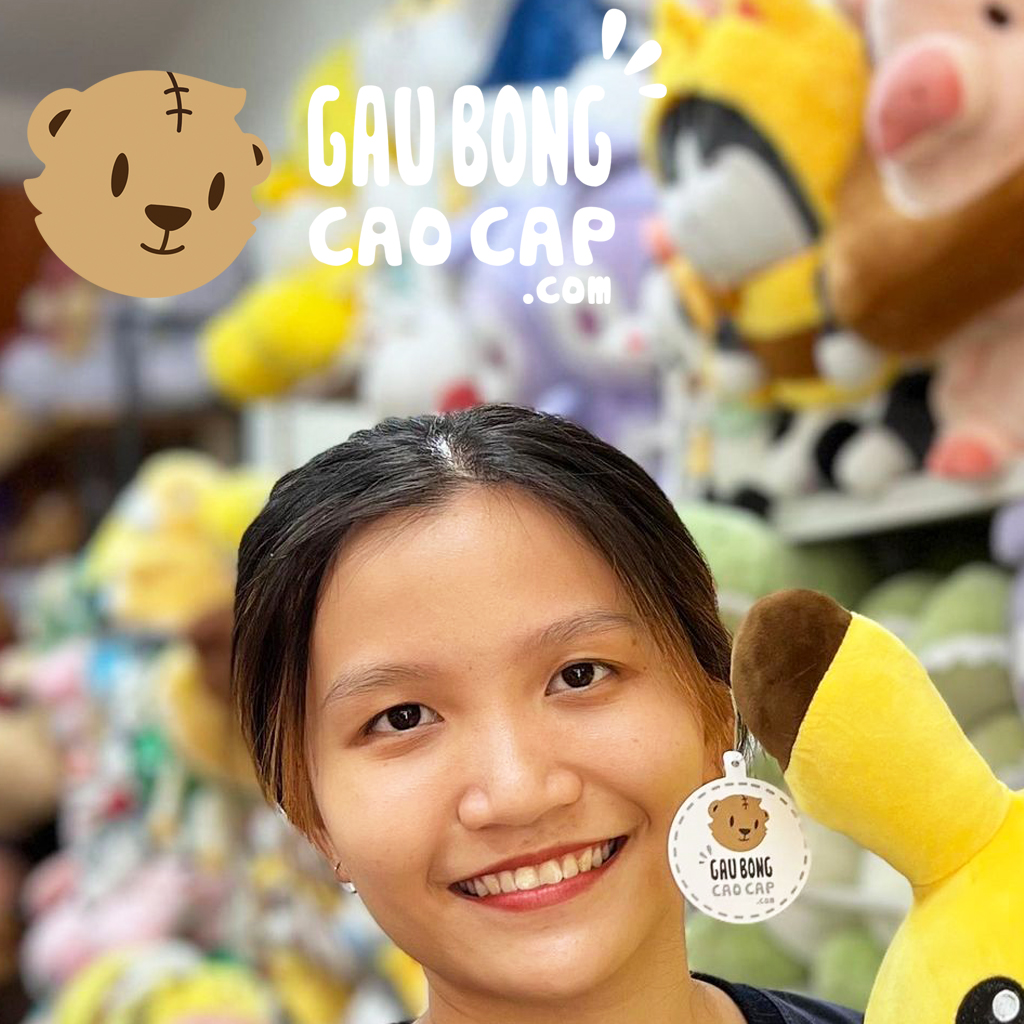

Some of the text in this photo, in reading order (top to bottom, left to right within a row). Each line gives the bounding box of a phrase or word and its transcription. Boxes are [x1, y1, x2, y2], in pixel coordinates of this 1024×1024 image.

[710, 856, 773, 880] GAU BONG
[712, 881, 775, 897] CAO CAP
